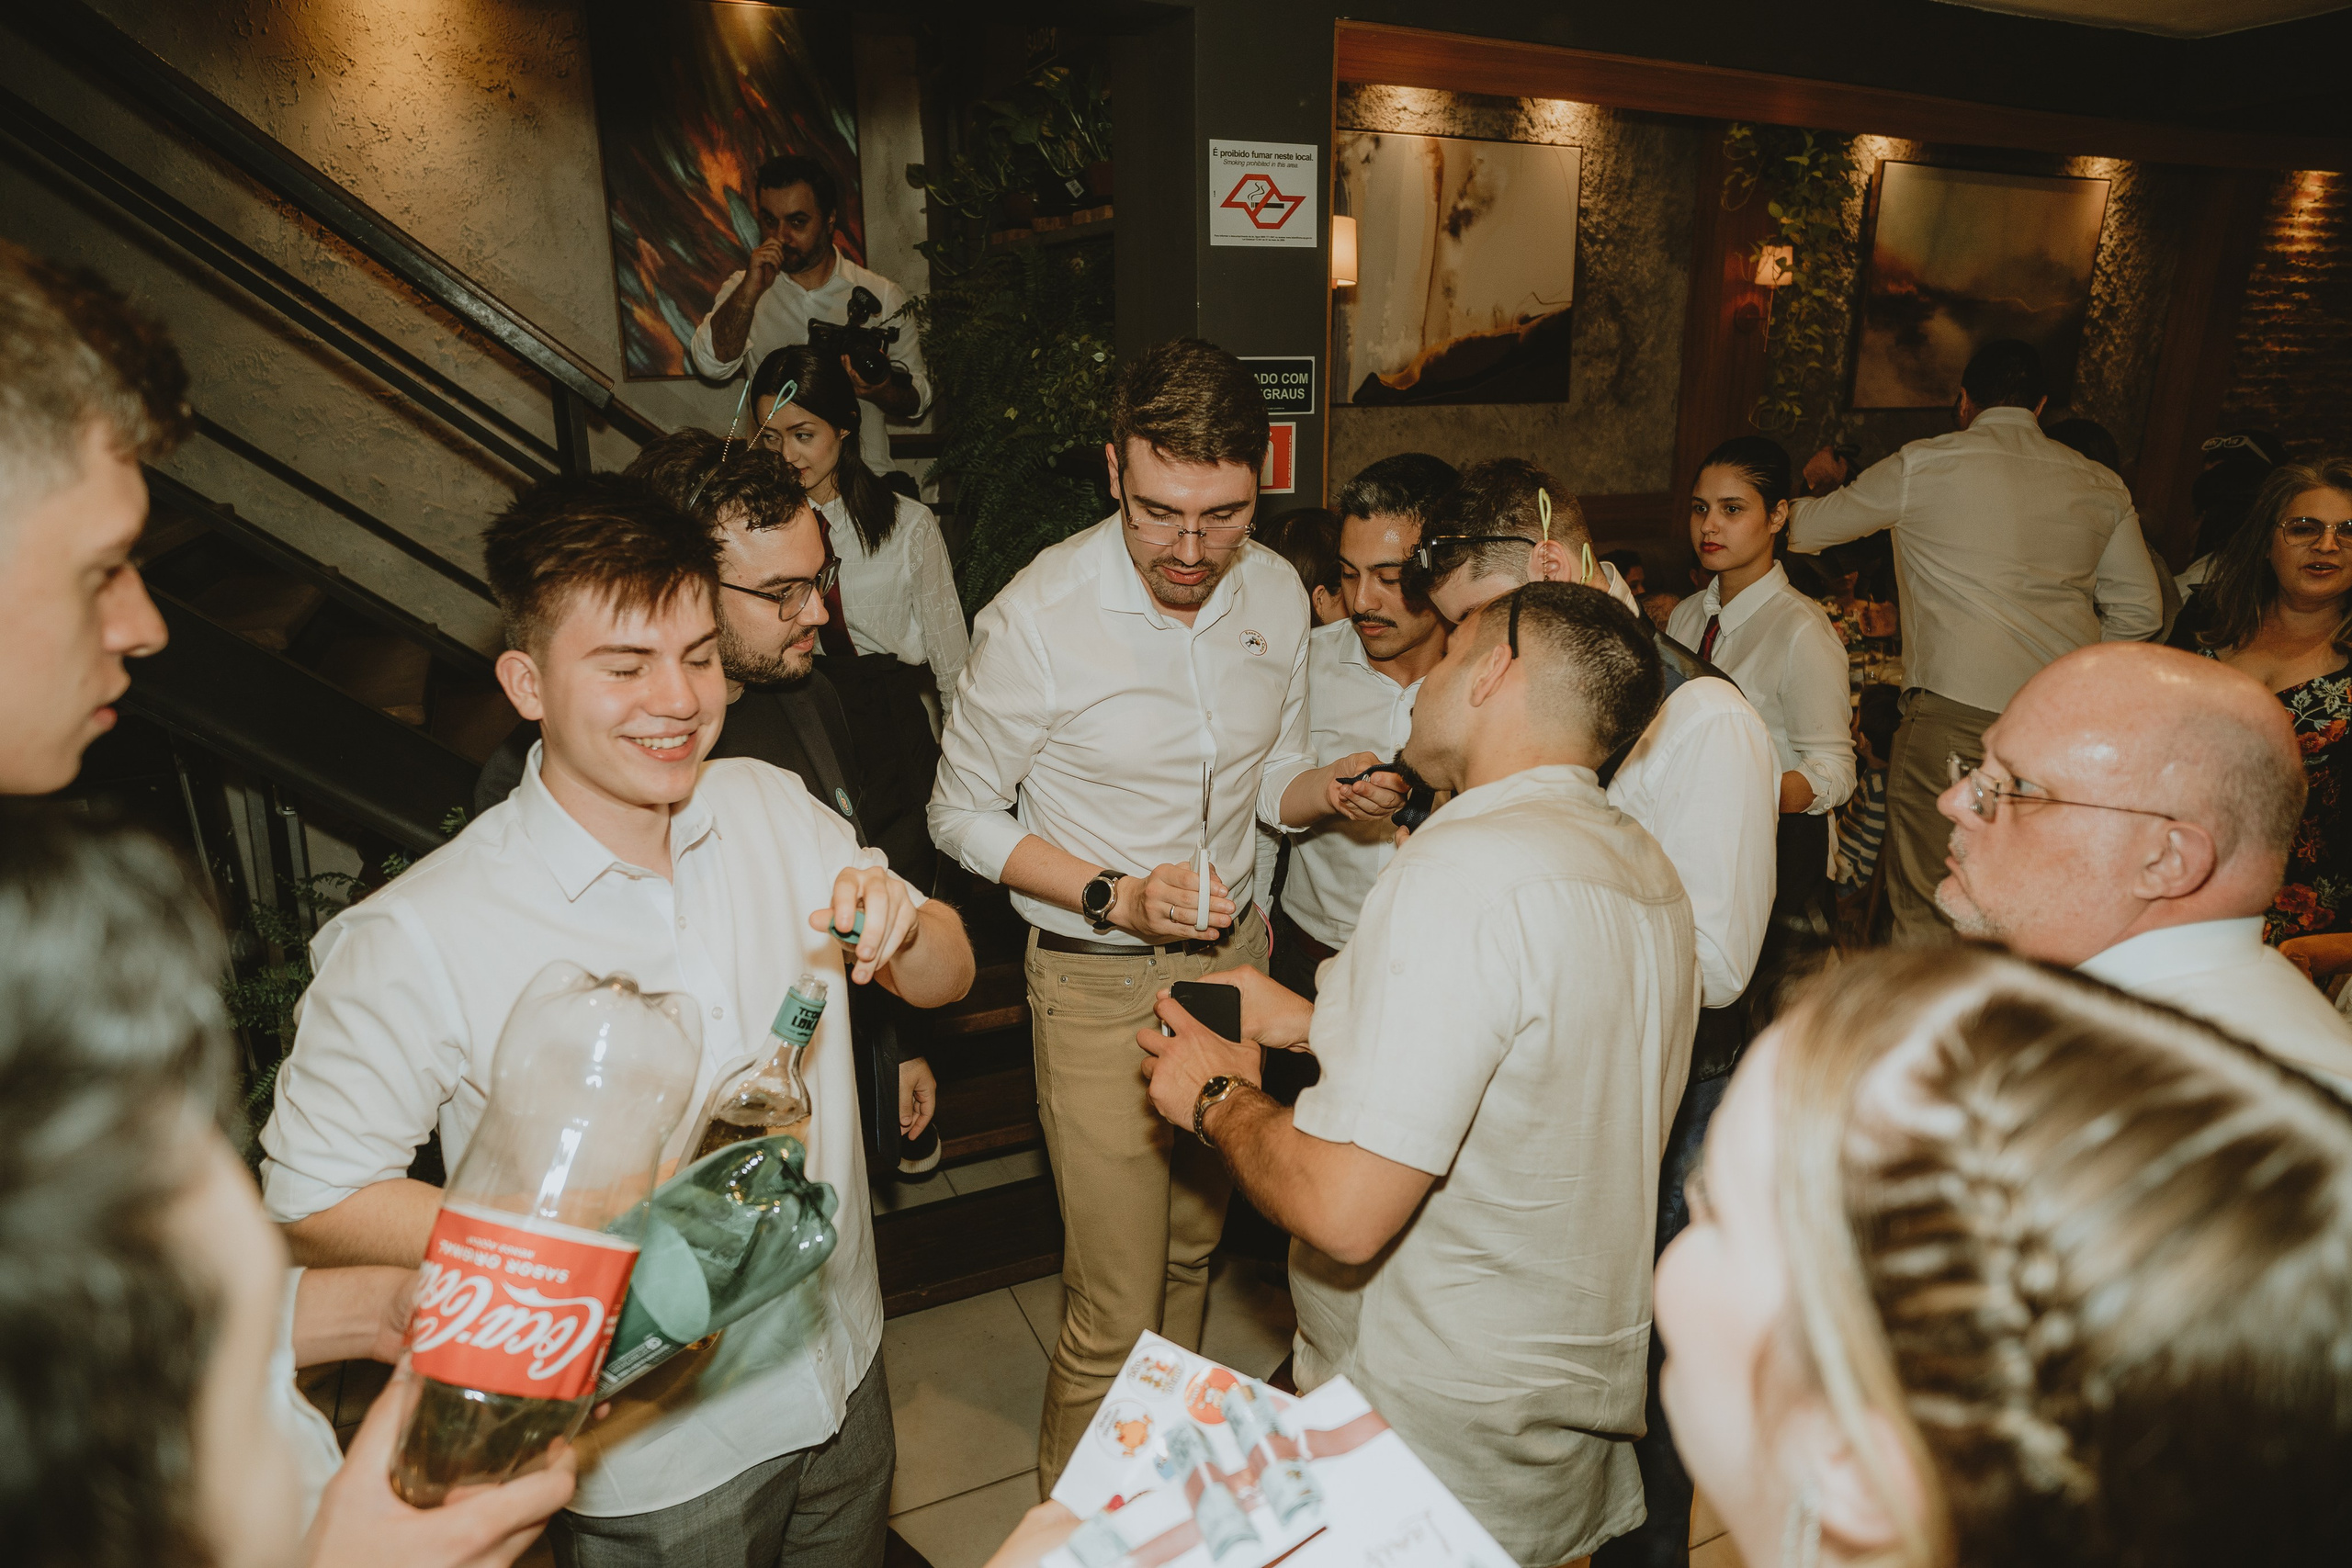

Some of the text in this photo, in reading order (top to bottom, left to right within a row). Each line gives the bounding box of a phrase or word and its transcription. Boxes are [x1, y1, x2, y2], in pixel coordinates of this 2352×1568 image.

[1213, 147, 1218, 156] É
[1220, 150, 1250, 159] proibido
[1251, 151, 1273, 159] fumar
[1295, 153, 1314, 162] local.
[1223, 159, 1246, 167] Smoking
[1281, 373, 1308, 384] COM
[1261, 388, 1306, 400] GRAUS
[438, 1239, 571, 1284] SABOR ORIGINAL
